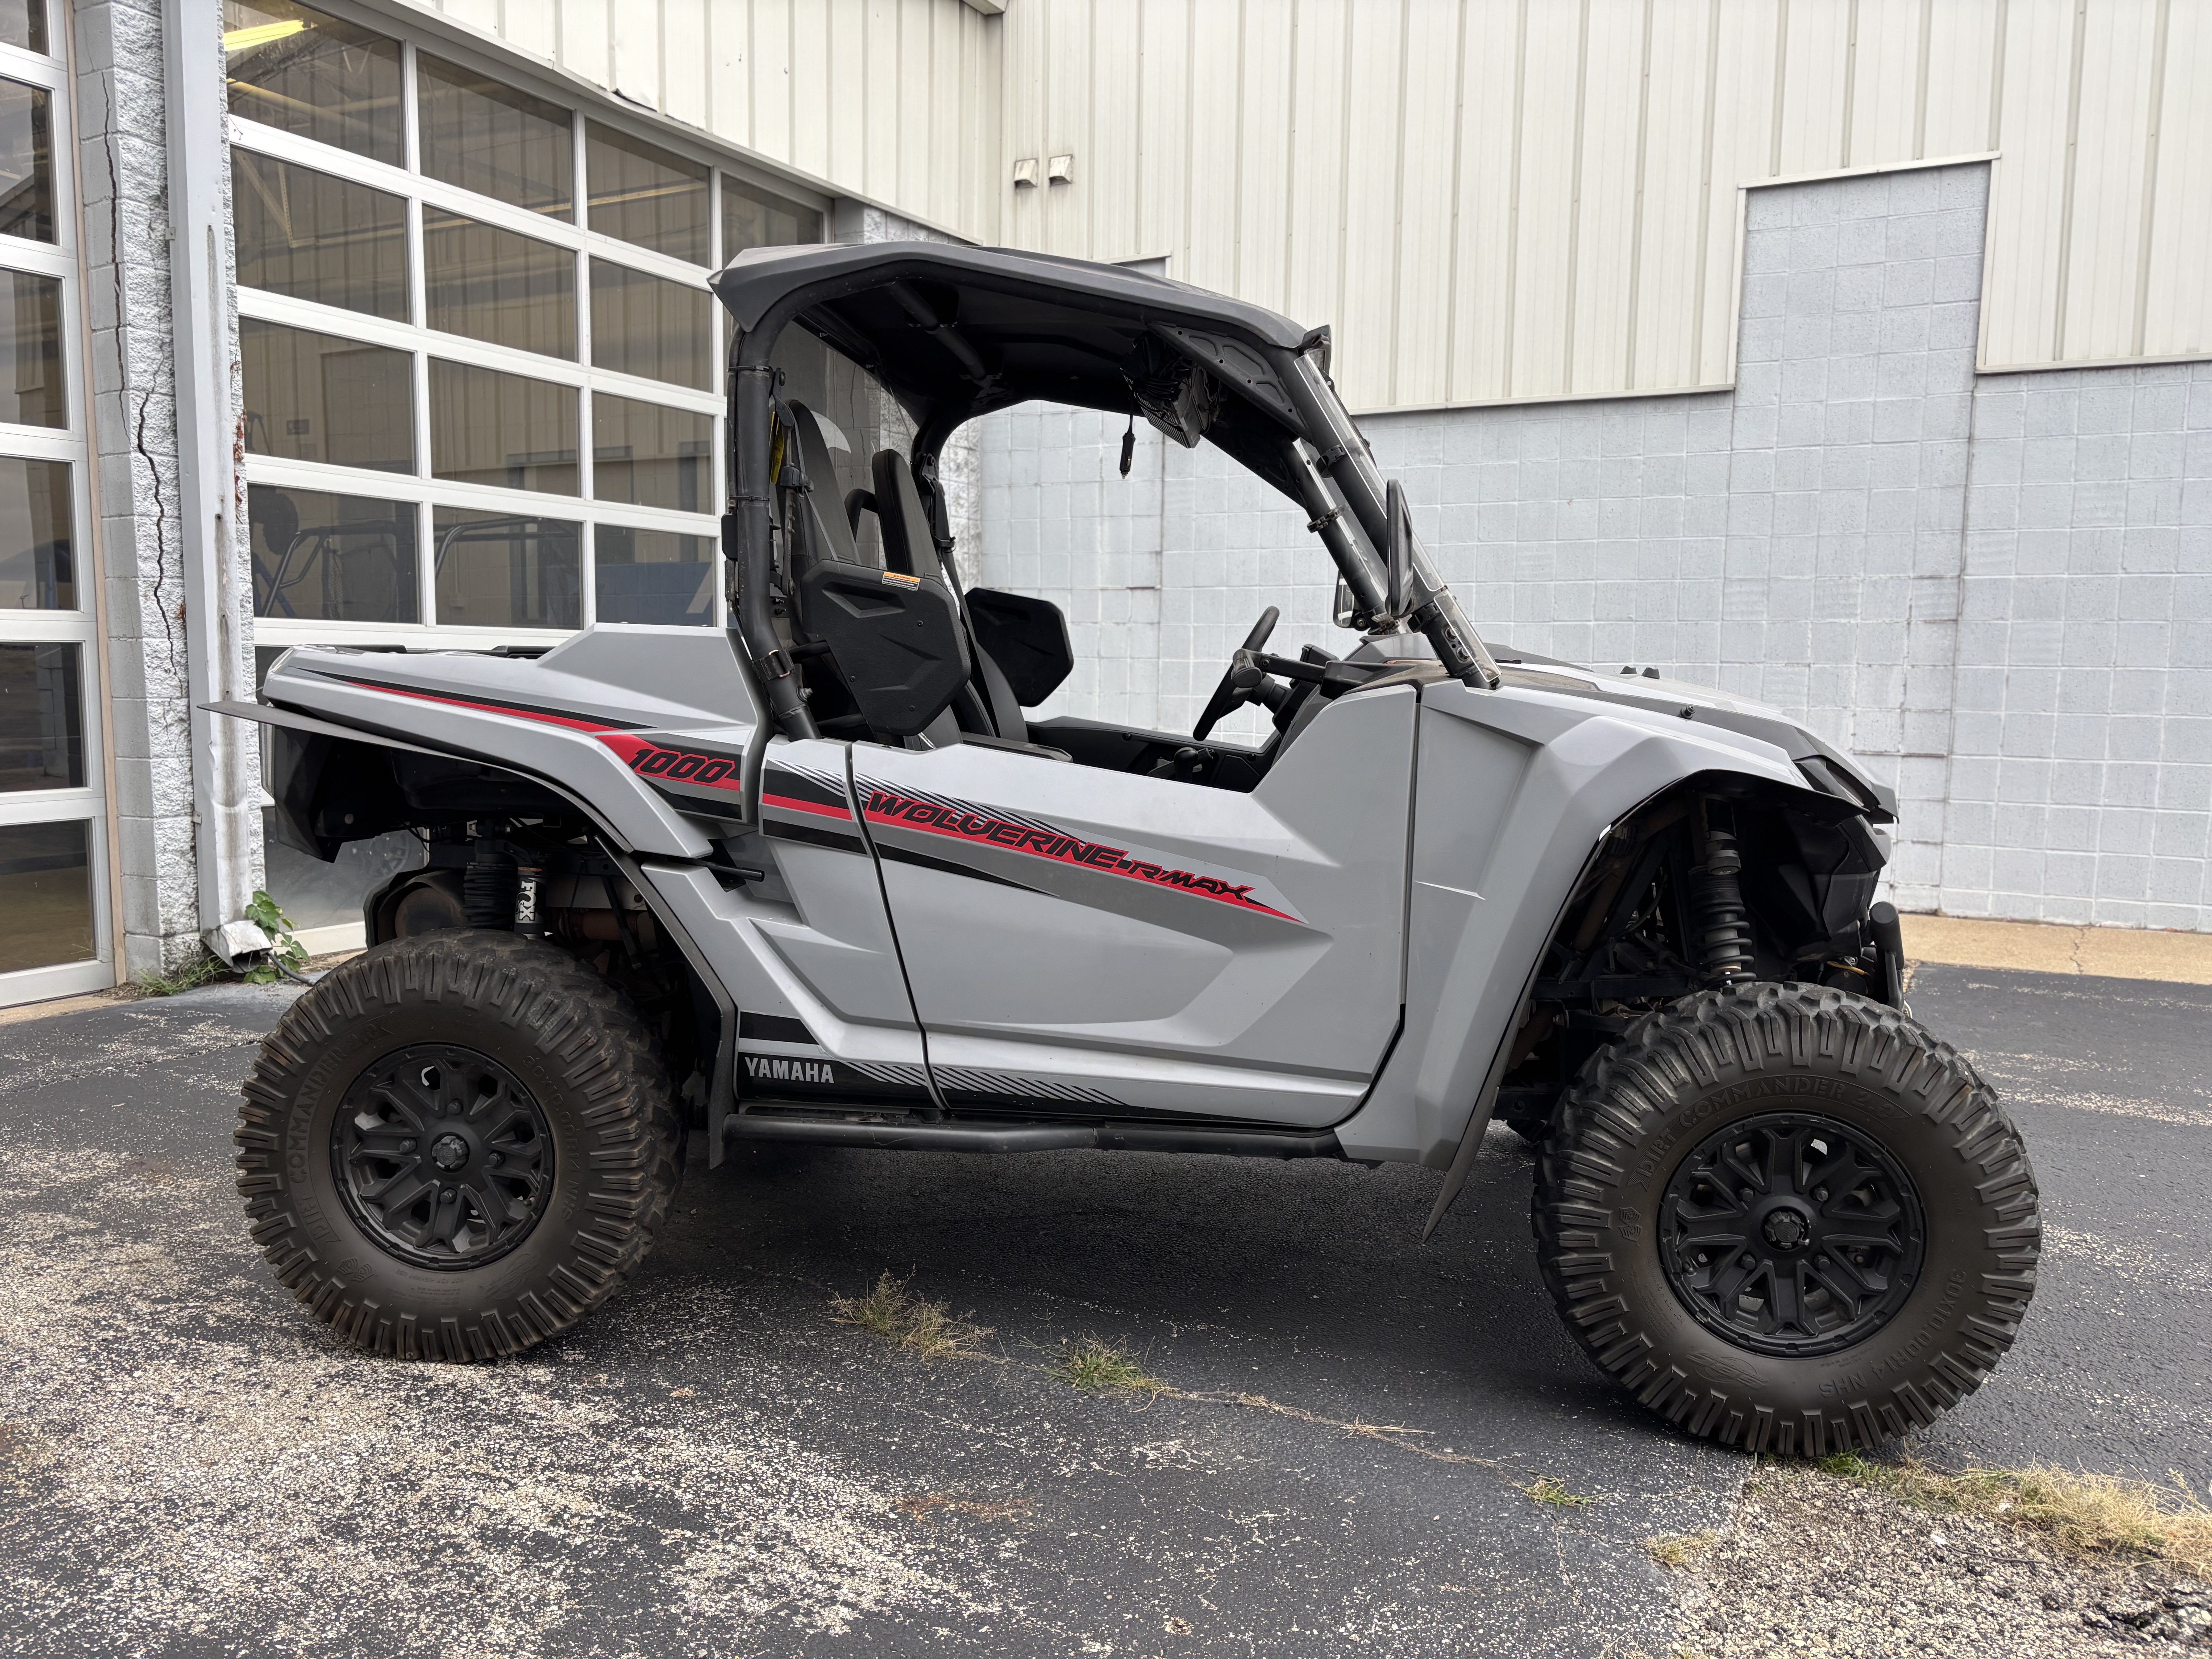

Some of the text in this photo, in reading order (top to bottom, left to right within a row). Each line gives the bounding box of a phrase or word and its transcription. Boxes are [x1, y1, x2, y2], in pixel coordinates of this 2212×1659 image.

[629, 749, 732, 783] 1000
[868, 791, 1252, 900] WOLVERINE RMAX
[516, 881, 537, 921] FOX
[744, 1057, 835, 1084] YAMAHA
[288, 1046, 347, 1184] COMMANDER
[1637, 1128, 1677, 1178] DIRT
[1680, 1077, 1846, 1128] COMMANDER
[297, 1196, 332, 1243] DIRT
[561, 1179, 580, 1221] NHS
[1872, 1268, 1968, 1381] 30X10.00R14
[1819, 1371, 1868, 1398] NHS
